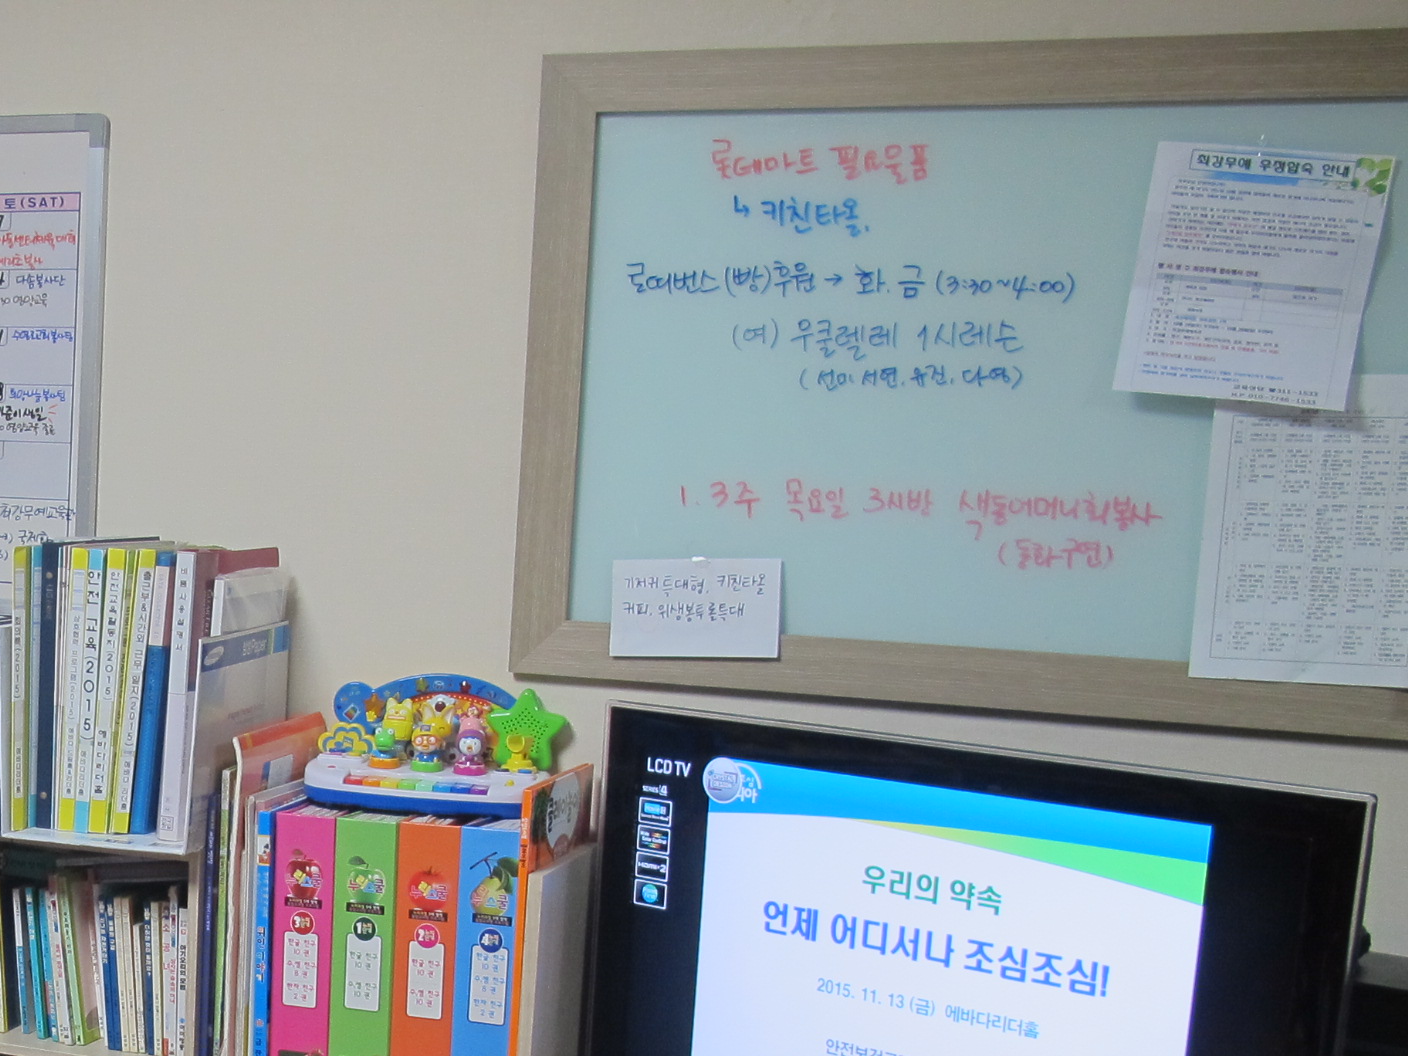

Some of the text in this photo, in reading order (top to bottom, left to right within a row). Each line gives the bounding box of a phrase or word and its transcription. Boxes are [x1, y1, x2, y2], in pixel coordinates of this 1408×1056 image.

[1322, 164, 1351, 178] 안내
[4, 198, 64, 210] 토(SAT)
[899, 264, 925, 299] 금
[731, 322, 780, 351] (여)
[790, 317, 897, 360] 우쿨렐레
[86, 570, 101, 605] 안전
[647, 757, 691, 778] LCD TV
[861, 864, 1004, 916] 우리의 약속
[762, 899, 1112, 1000] 언제 어디서나 조심조심!
[816, 977, 1040, 1040] 2015. 11. 13 (금) 에바다리더홈
